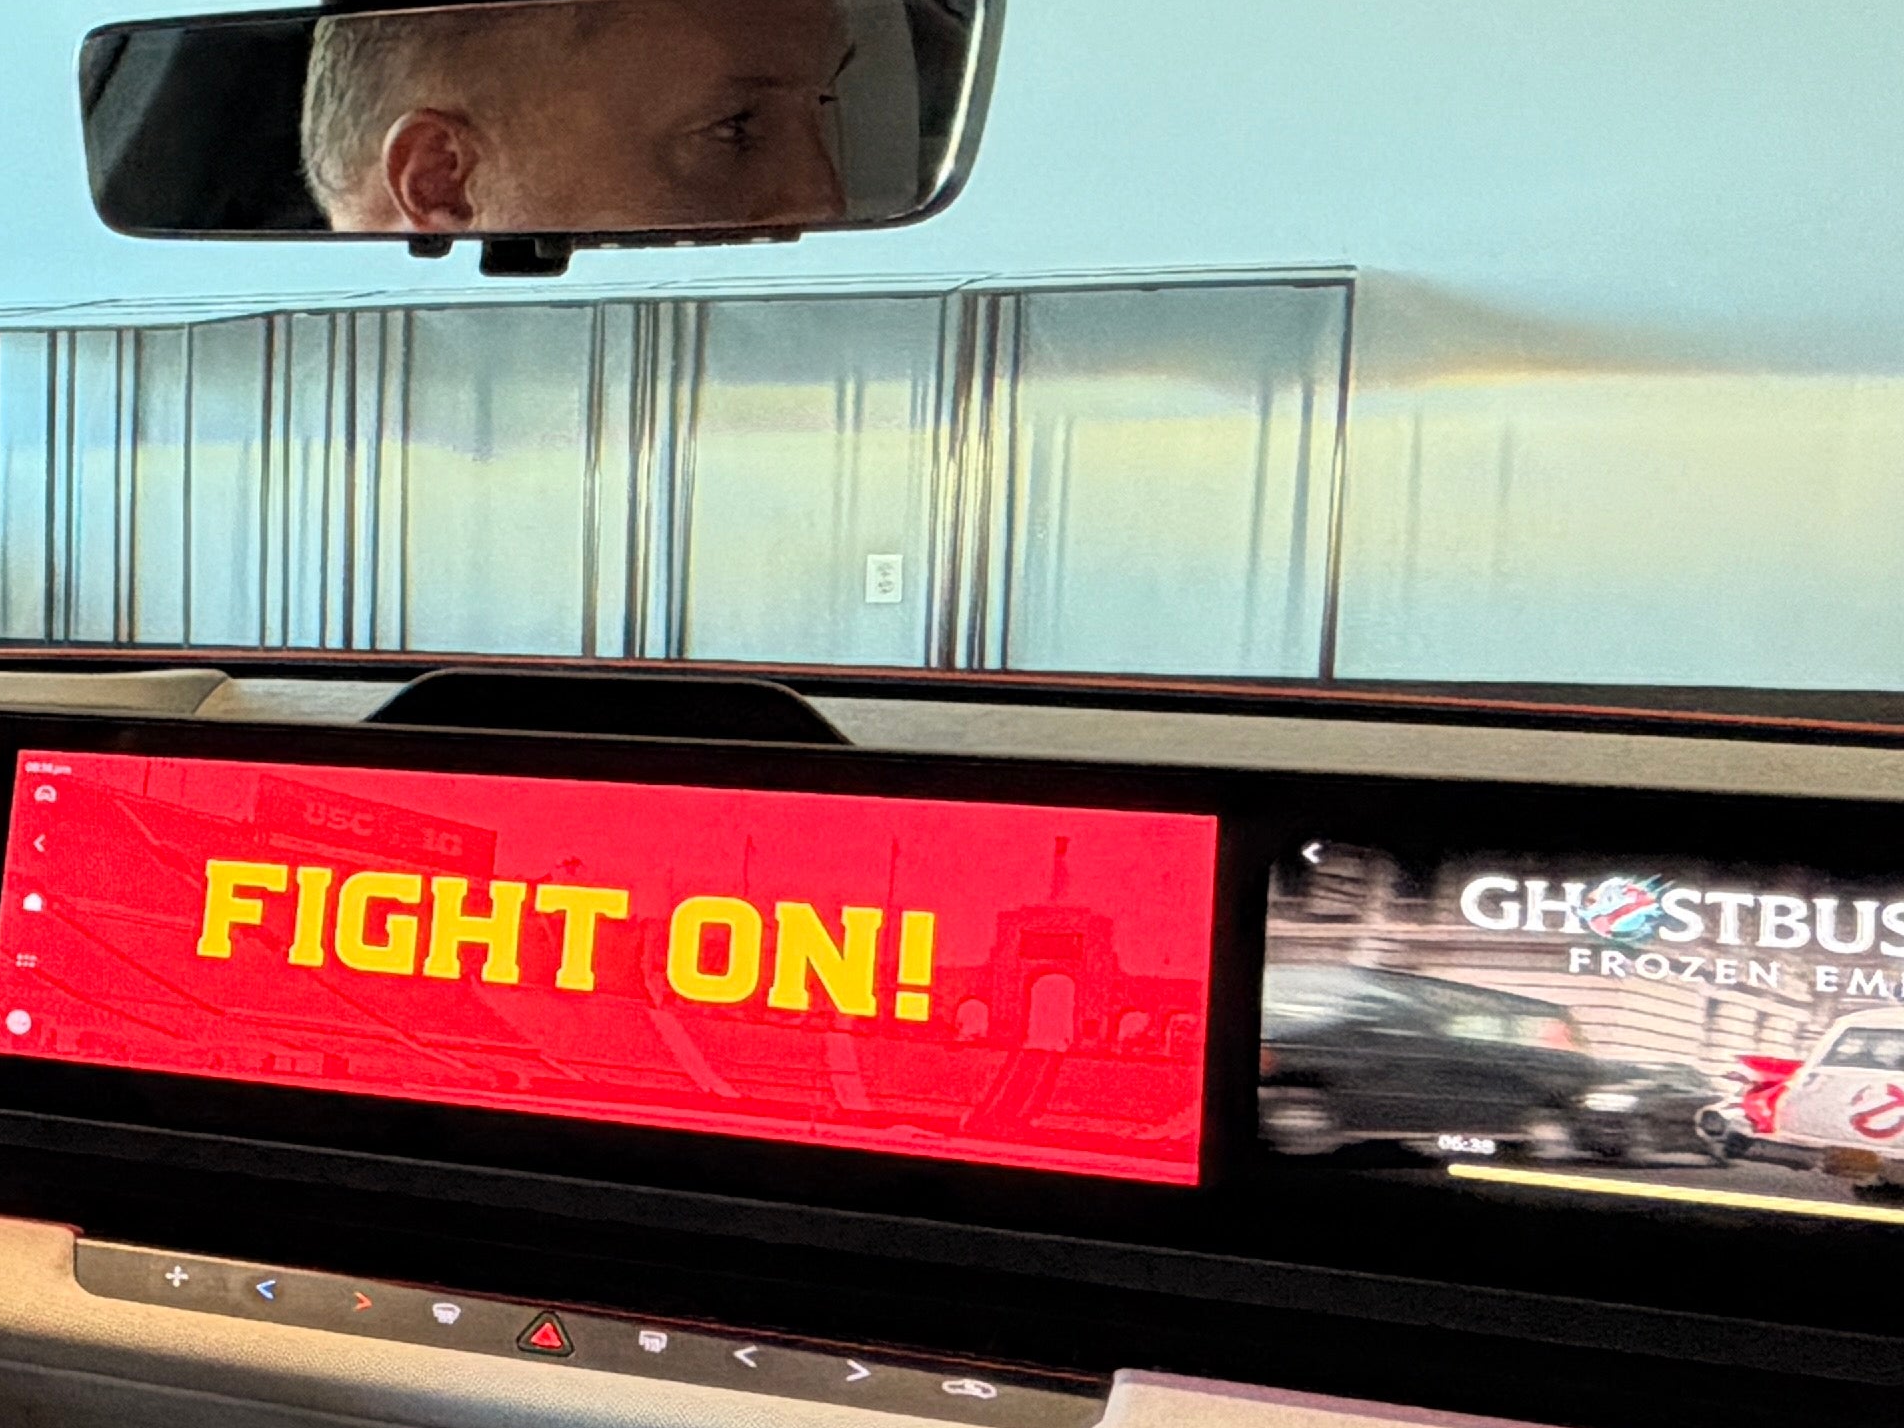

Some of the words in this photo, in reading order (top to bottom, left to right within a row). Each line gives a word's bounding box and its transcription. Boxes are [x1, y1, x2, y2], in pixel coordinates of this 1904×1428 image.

[195, 858, 629, 992] FIGHT
[666, 894, 936, 1022] ON!
[1567, 946, 1783, 989] FROZEN
[1814, 964, 1904, 998] EM
